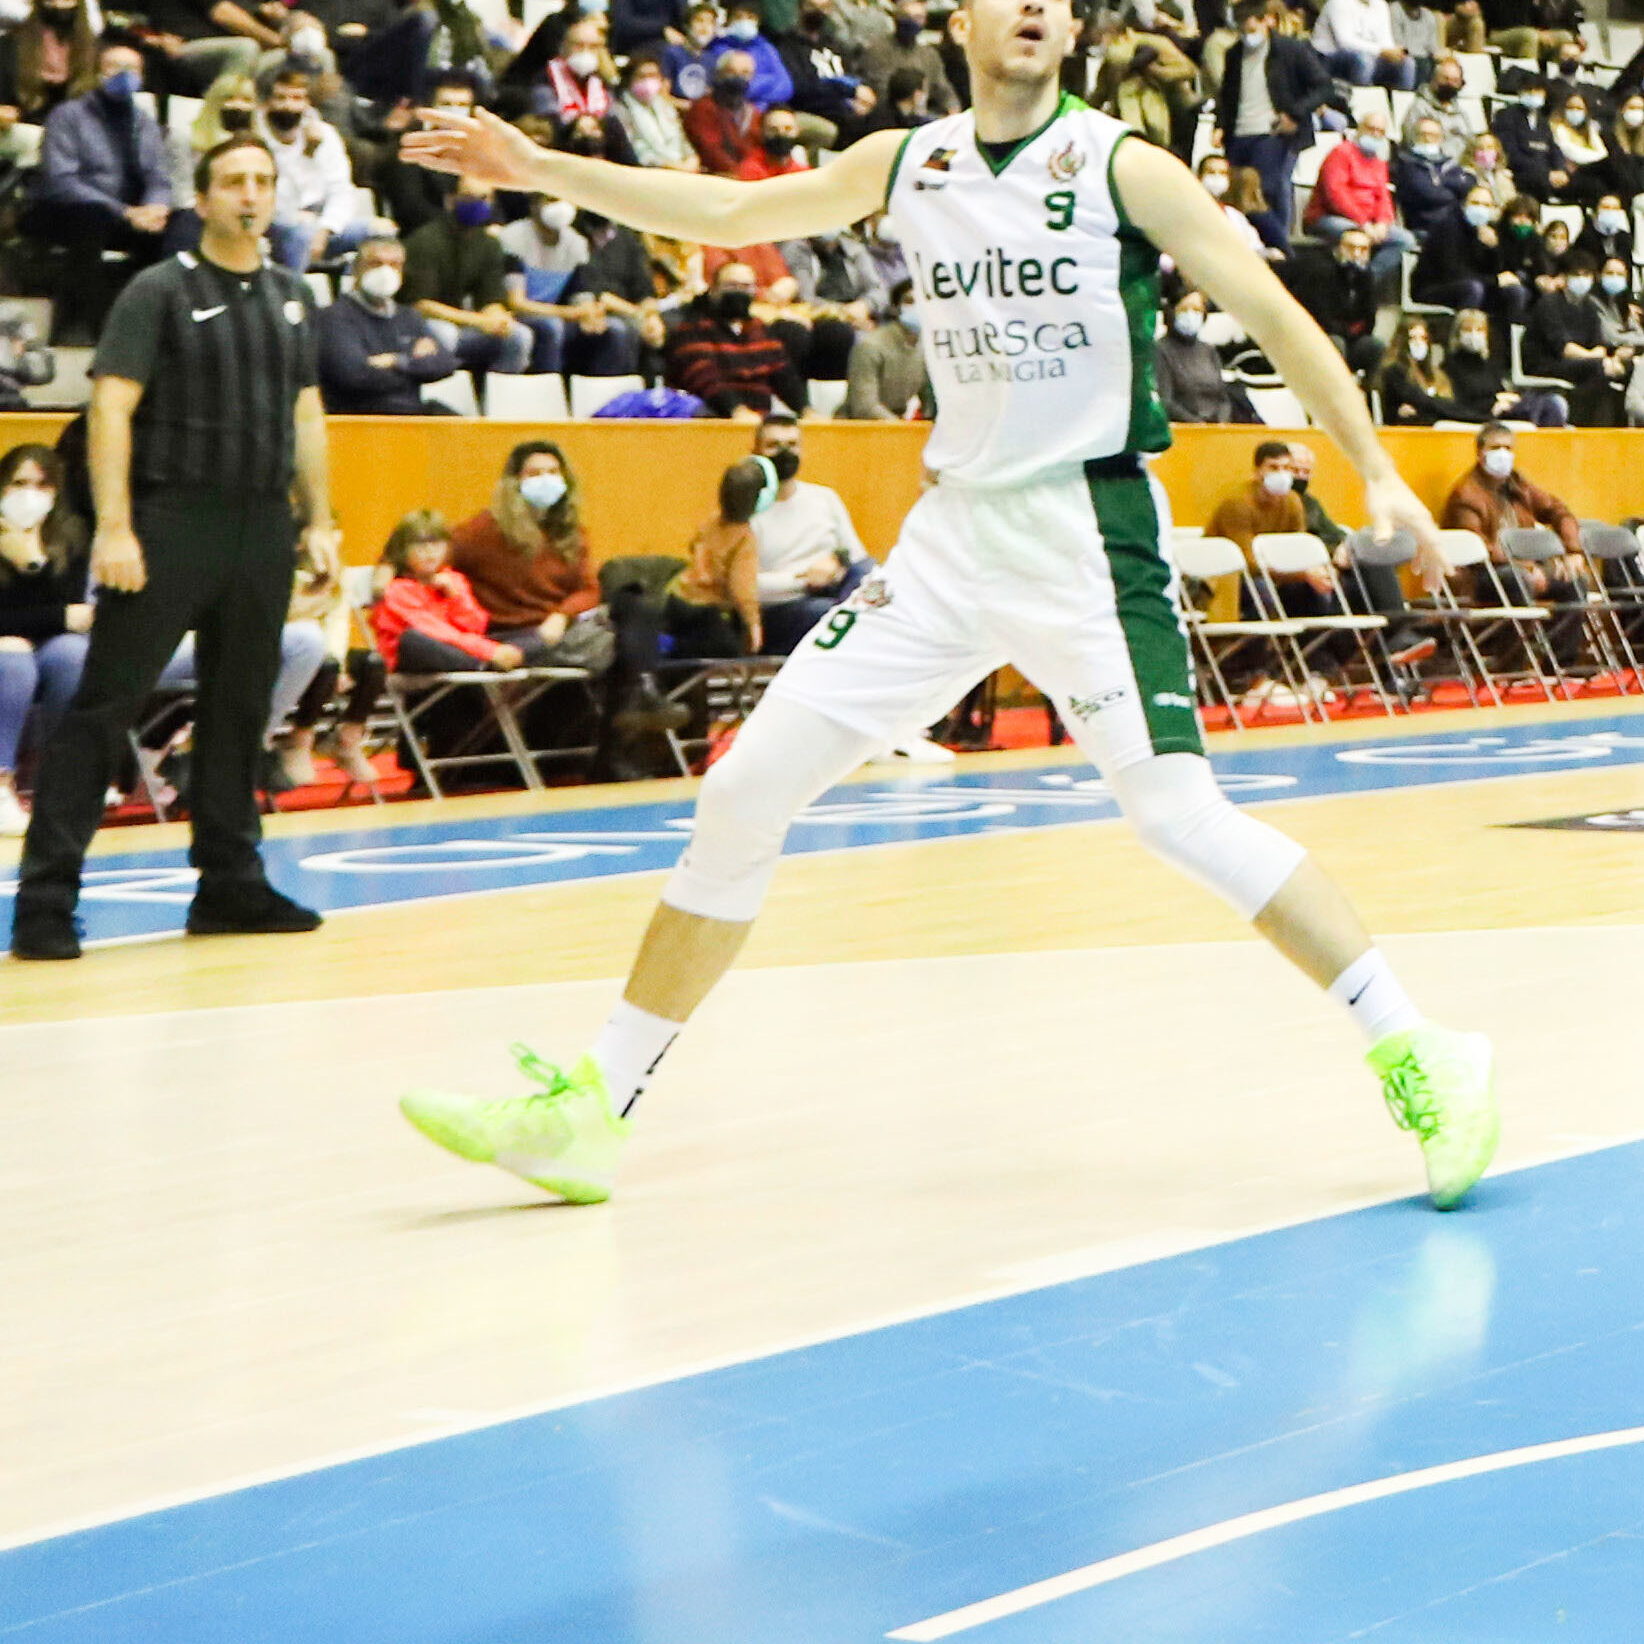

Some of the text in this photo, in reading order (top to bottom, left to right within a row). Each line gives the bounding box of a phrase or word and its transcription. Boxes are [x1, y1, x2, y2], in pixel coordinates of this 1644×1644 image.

[1044, 191, 1075, 230] 9
[914, 246, 1079, 300] levitec
[813, 609, 857, 651] 9
